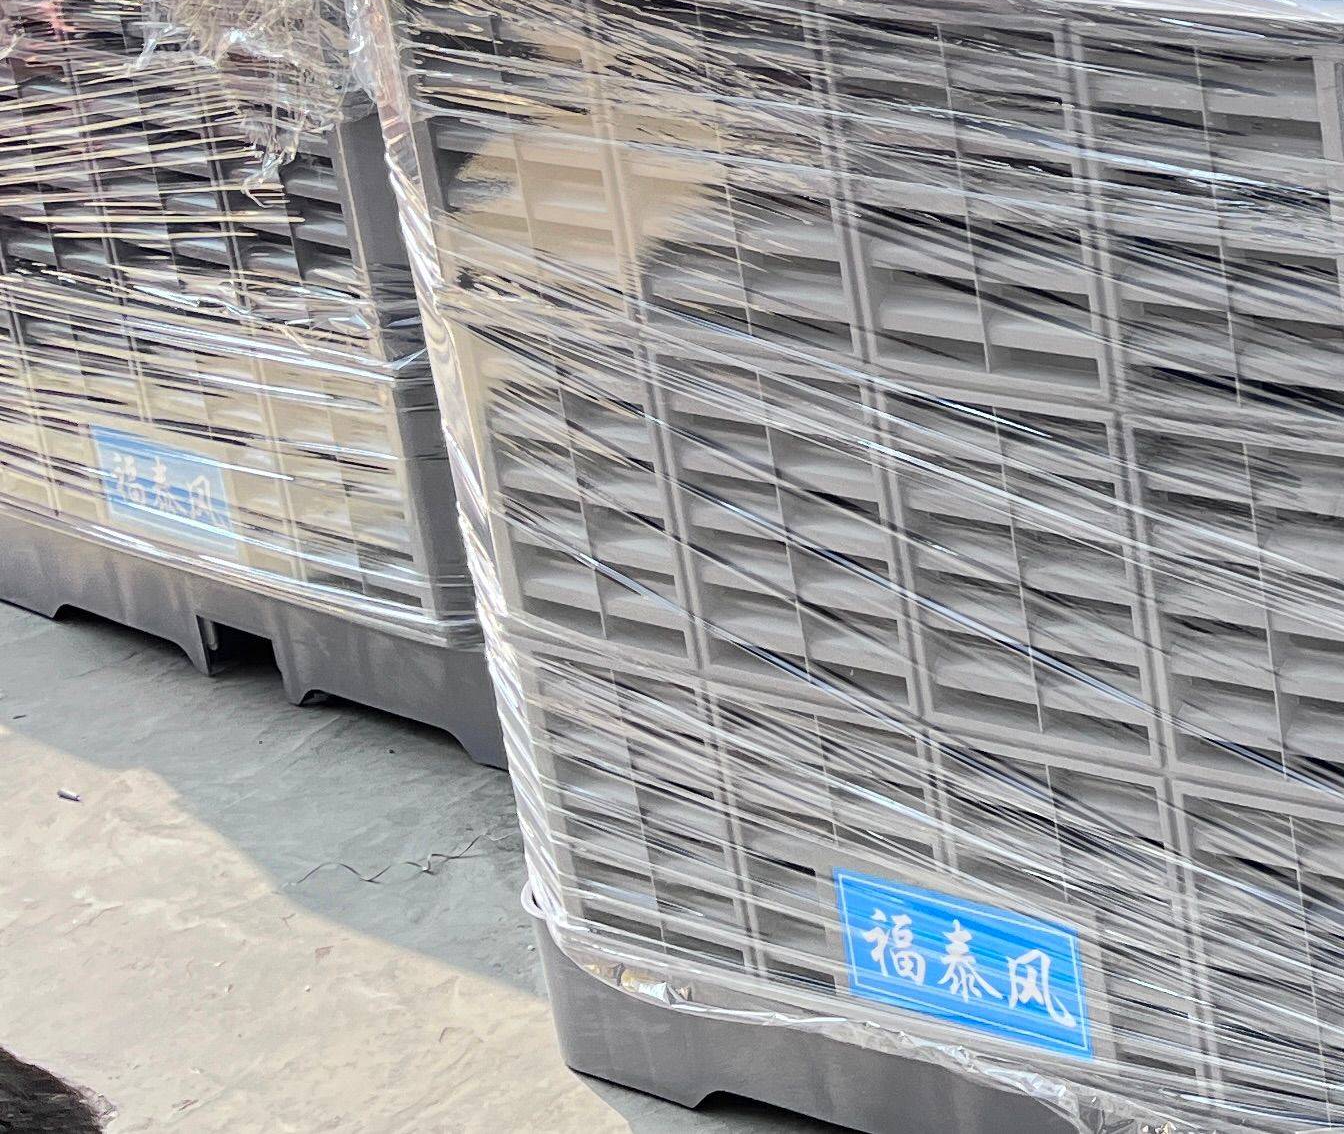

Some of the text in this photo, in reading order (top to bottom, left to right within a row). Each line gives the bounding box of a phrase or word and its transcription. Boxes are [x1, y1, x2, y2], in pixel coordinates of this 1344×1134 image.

[112, 452, 233, 528] 福泰风
[861, 907, 1077, 1028] 福泰风
